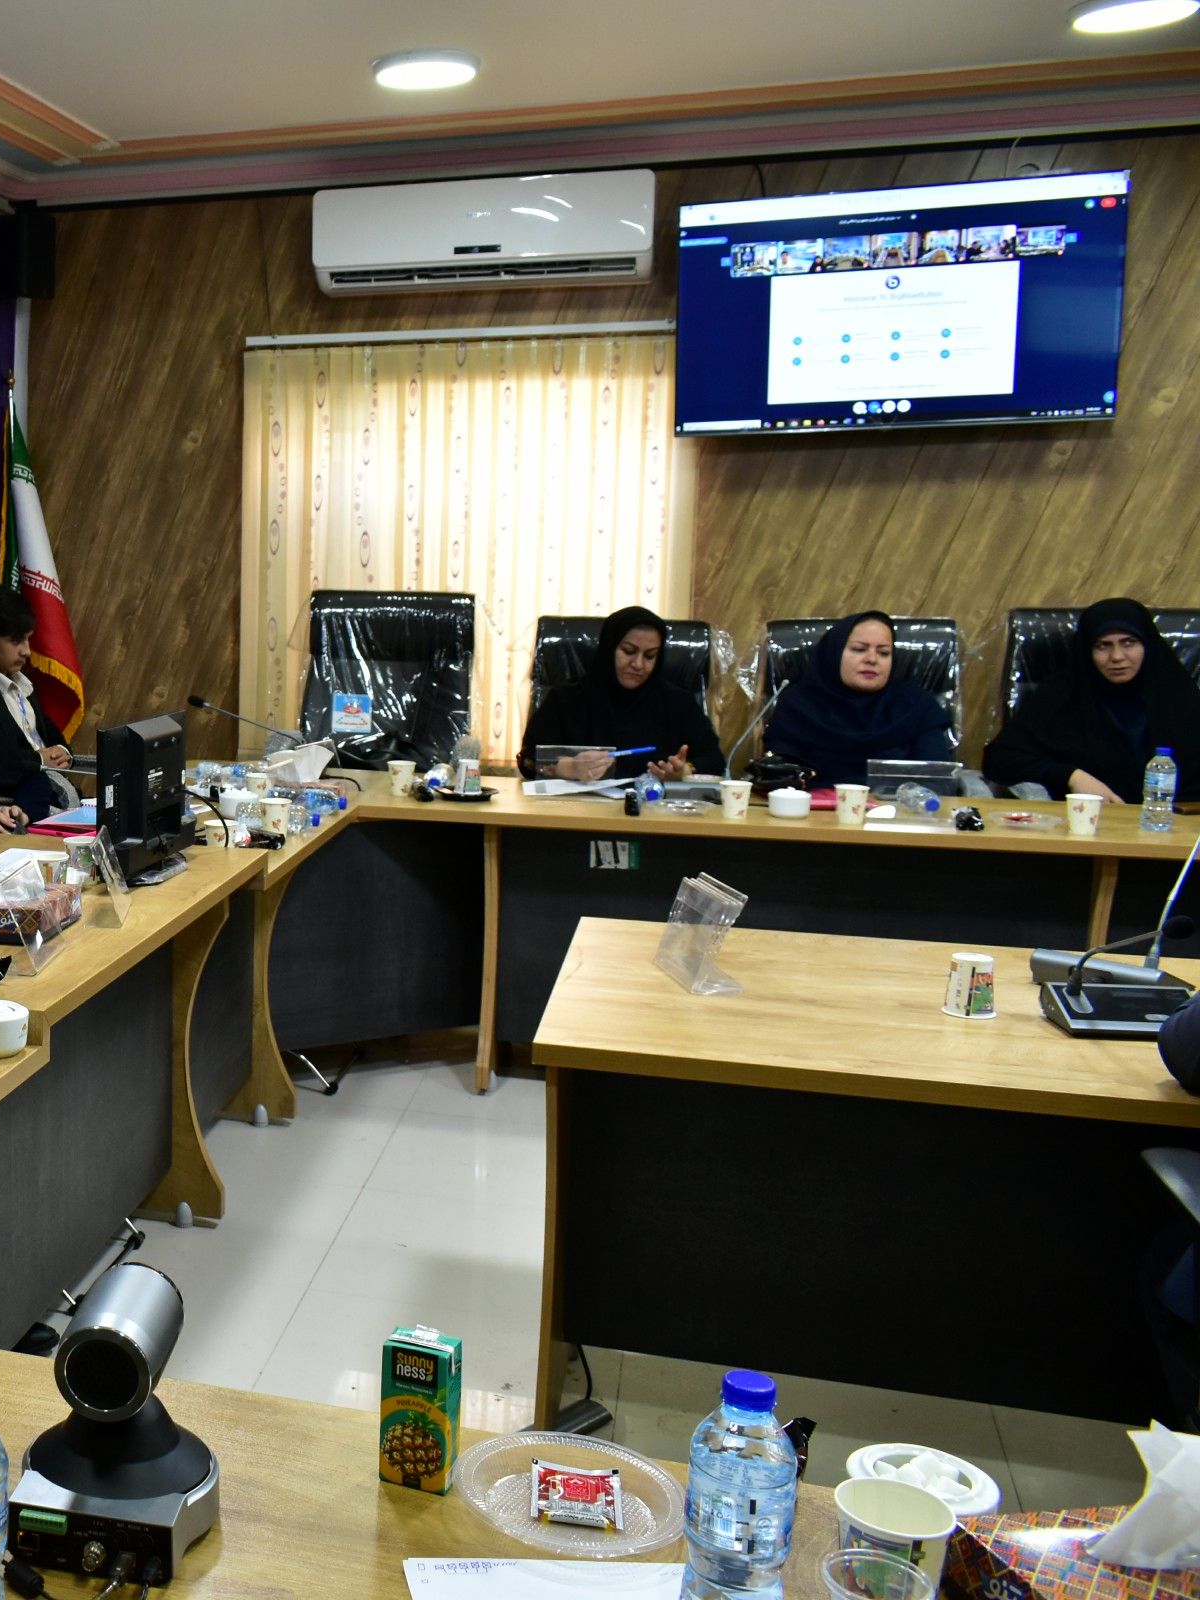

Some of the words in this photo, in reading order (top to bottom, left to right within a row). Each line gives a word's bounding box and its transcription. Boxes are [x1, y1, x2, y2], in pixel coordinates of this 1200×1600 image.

[396, 1352, 434, 1375] sunny
[396, 1363, 426, 1381] ness
[396, 1400, 432, 1412] PINEAPPLE
